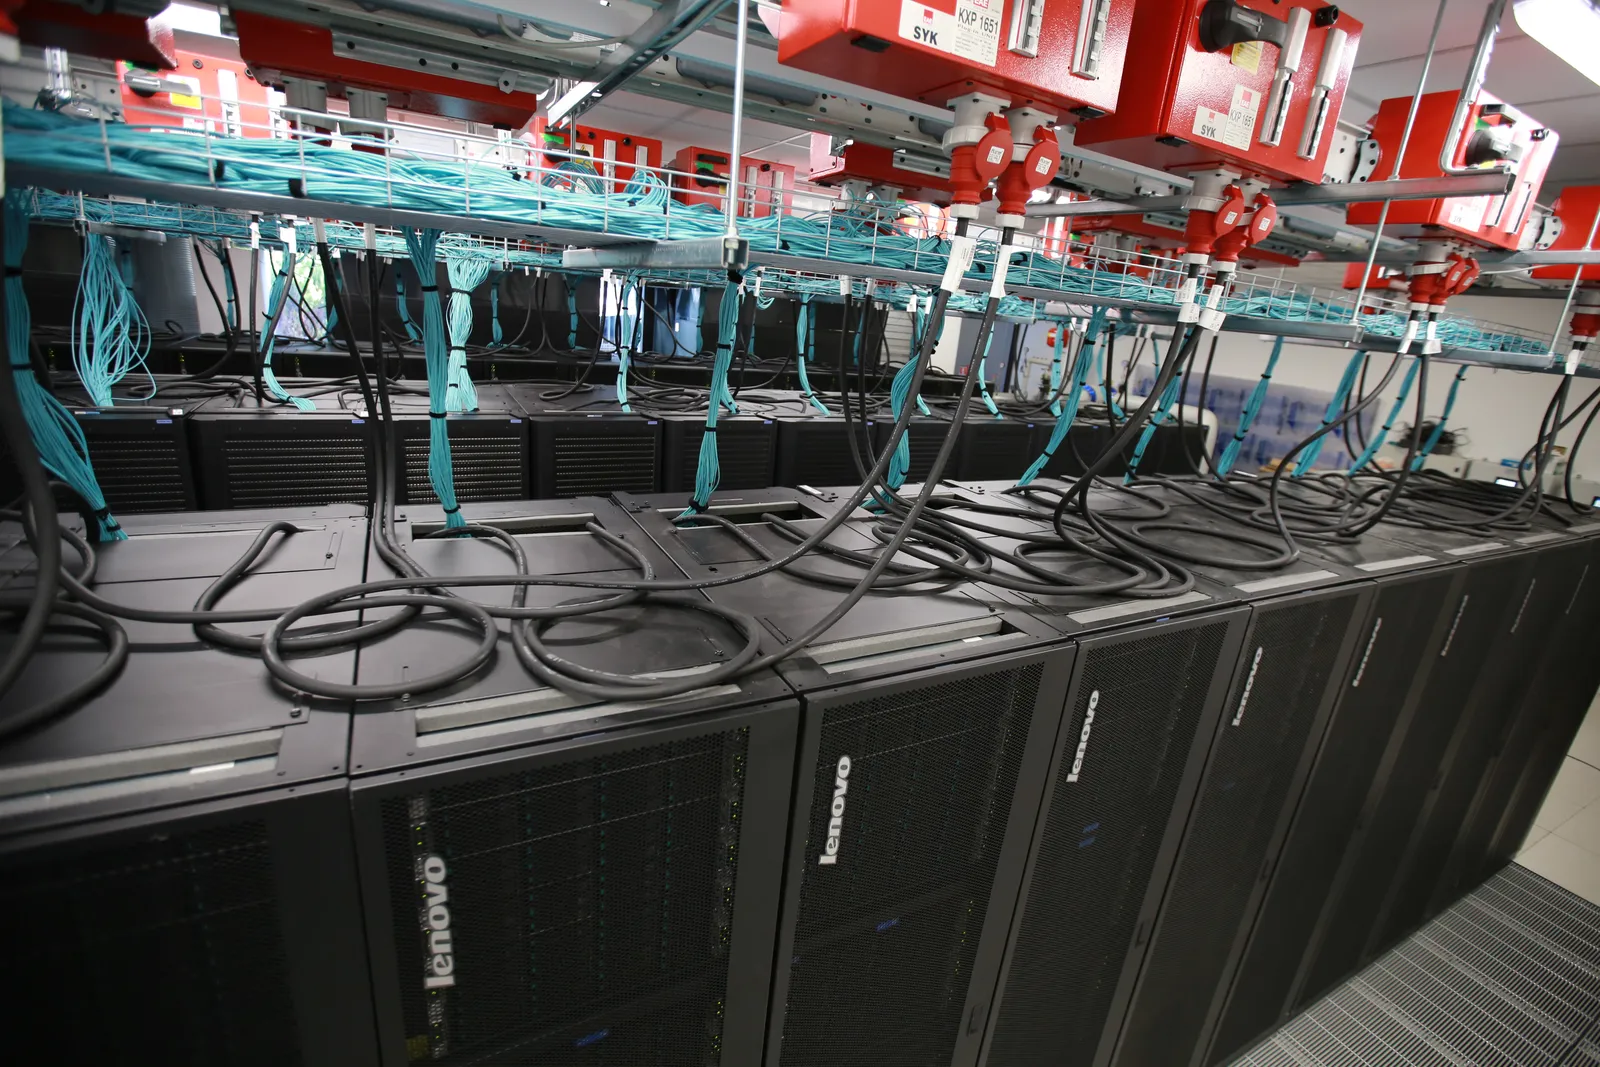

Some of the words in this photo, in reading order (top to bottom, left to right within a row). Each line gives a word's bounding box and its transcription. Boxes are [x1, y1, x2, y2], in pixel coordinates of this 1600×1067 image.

[913, 26, 938, 45] SYK
[958, 7, 977, 26] KXP
[980, 15, 999, 34] 1651
[1200, 124, 1216, 138] SYK
[1232, 646, 1263, 727] lenovo
[1066, 690, 1099, 782] lenovo
[819, 756, 851, 864] lenovo
[424, 856, 454, 988] lenovo
